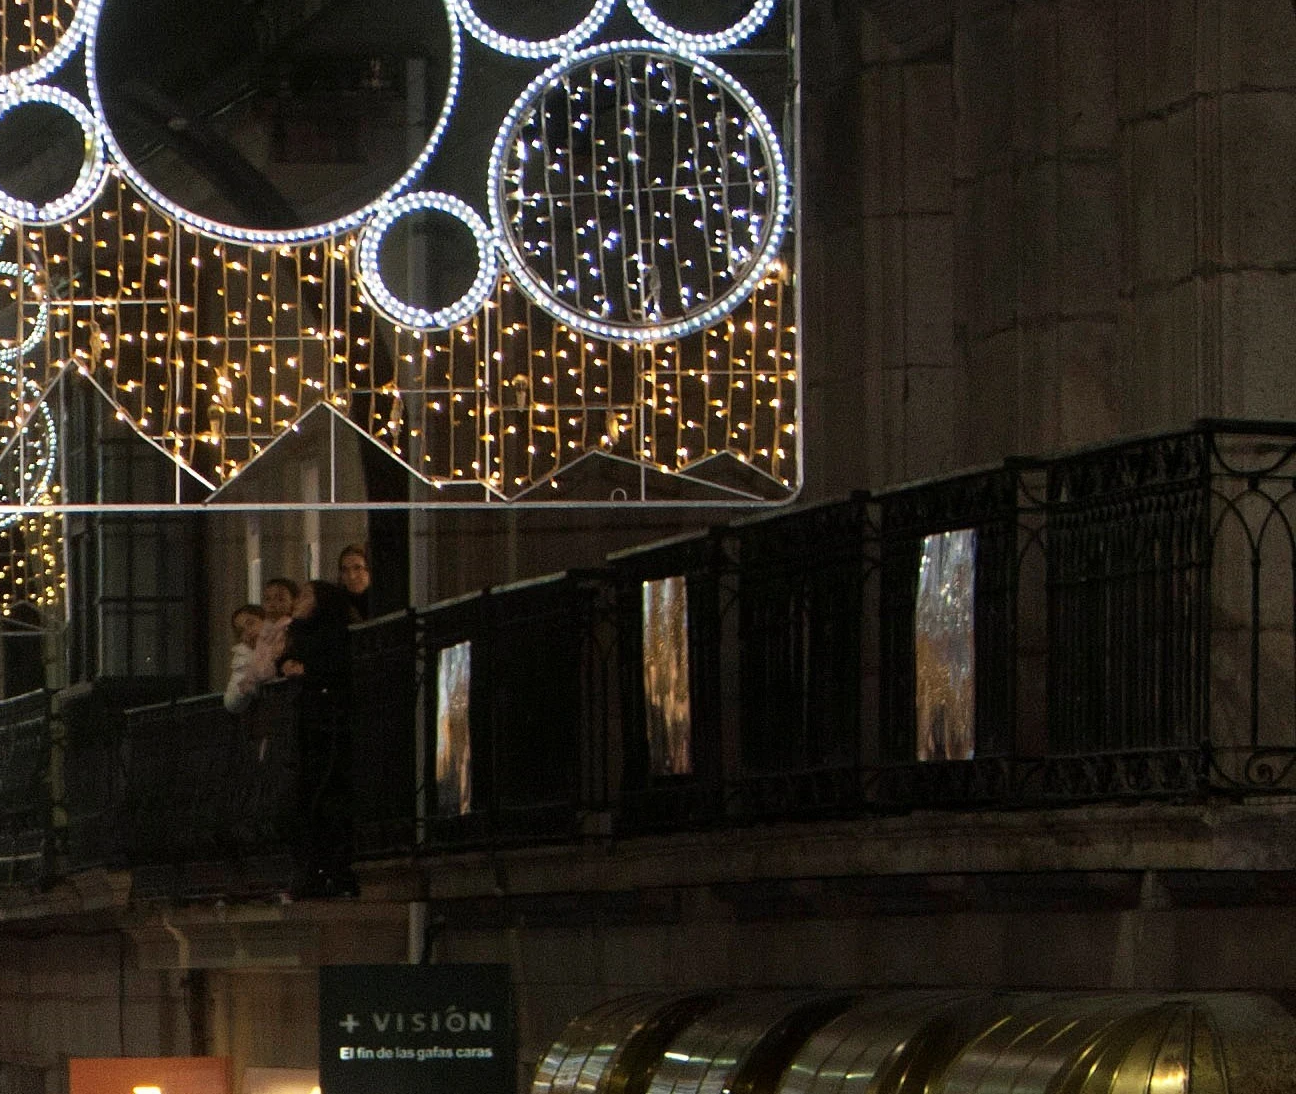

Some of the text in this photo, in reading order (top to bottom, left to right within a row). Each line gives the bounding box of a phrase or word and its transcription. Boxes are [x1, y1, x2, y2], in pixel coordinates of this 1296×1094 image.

[372, 1005, 492, 1033] VISIÓN
[339, 1045, 493, 1061] El fin de las gafas caras
